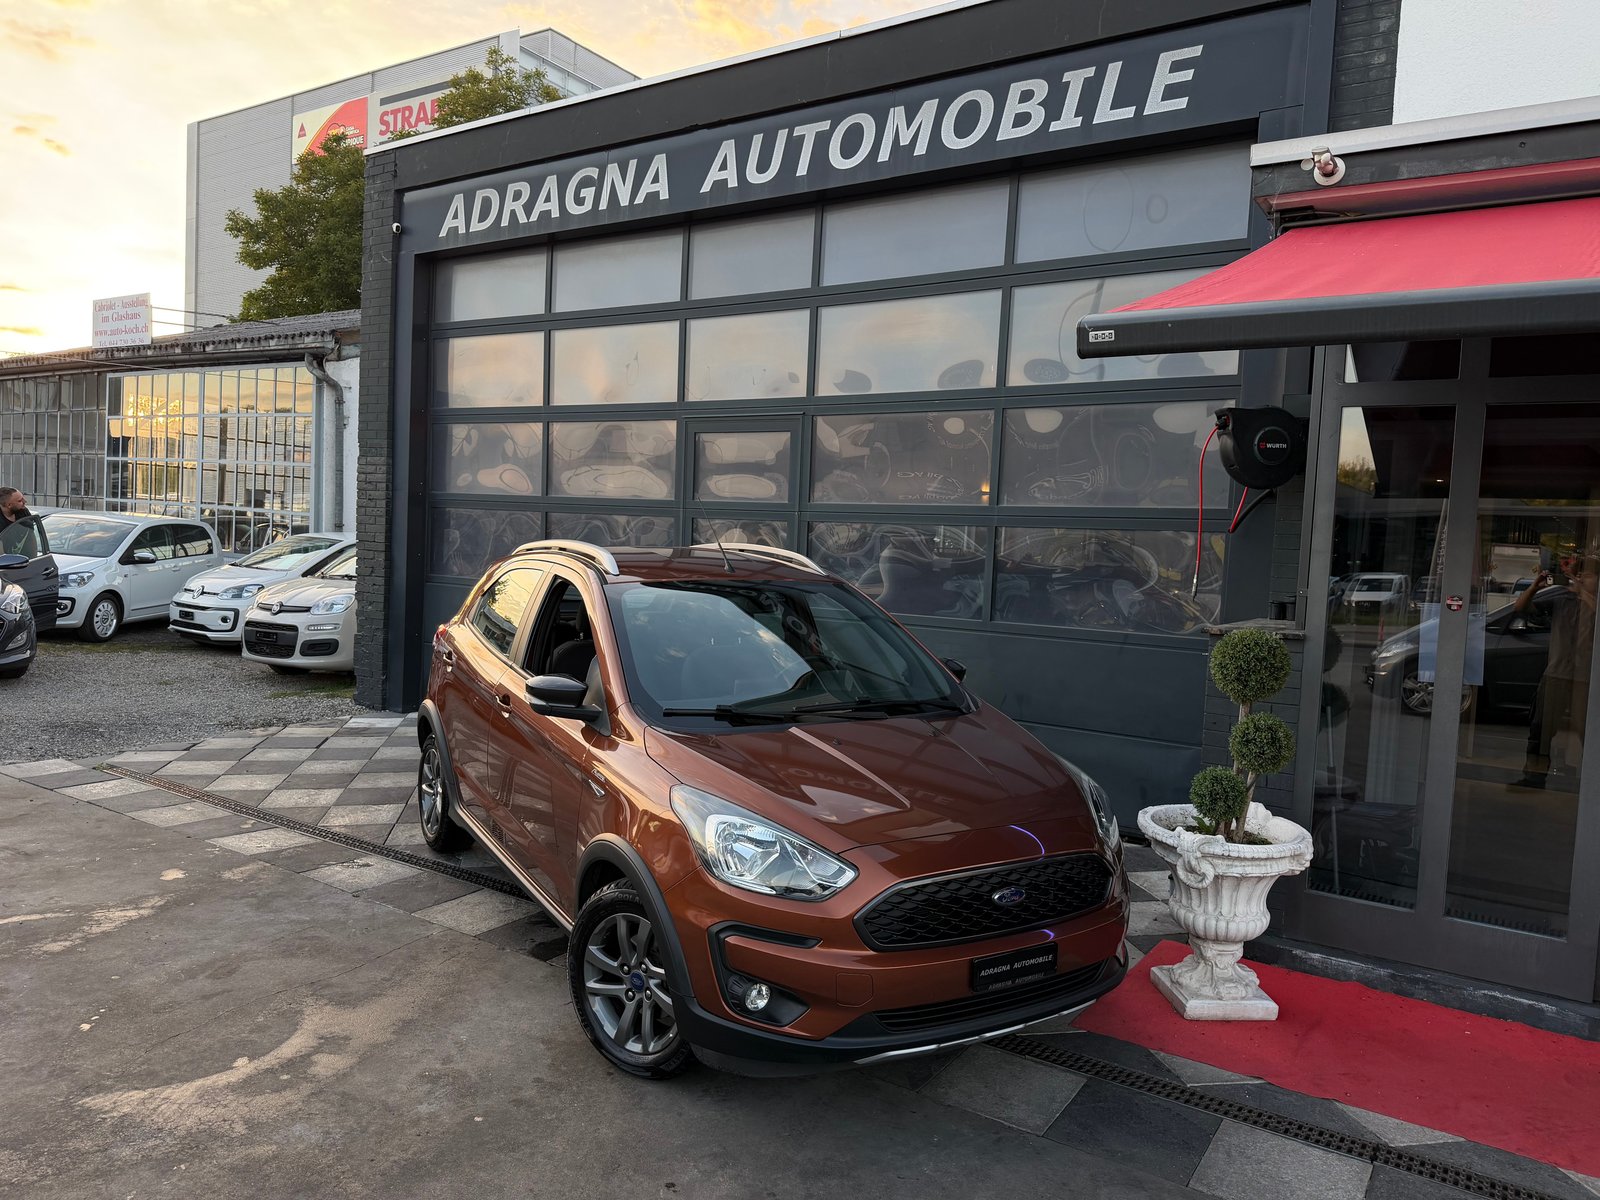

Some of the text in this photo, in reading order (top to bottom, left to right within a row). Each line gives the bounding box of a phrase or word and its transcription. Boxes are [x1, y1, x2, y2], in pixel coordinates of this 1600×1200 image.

[438, 44, 1204, 238] ADRAGNA AUTOMOBILE
[101, 310, 141, 323] im Glashaus
[95, 323, 148, 336] www.auto-koch.ch
[980, 954, 1053, 976] ADRAGNA AUTOMOBILE
